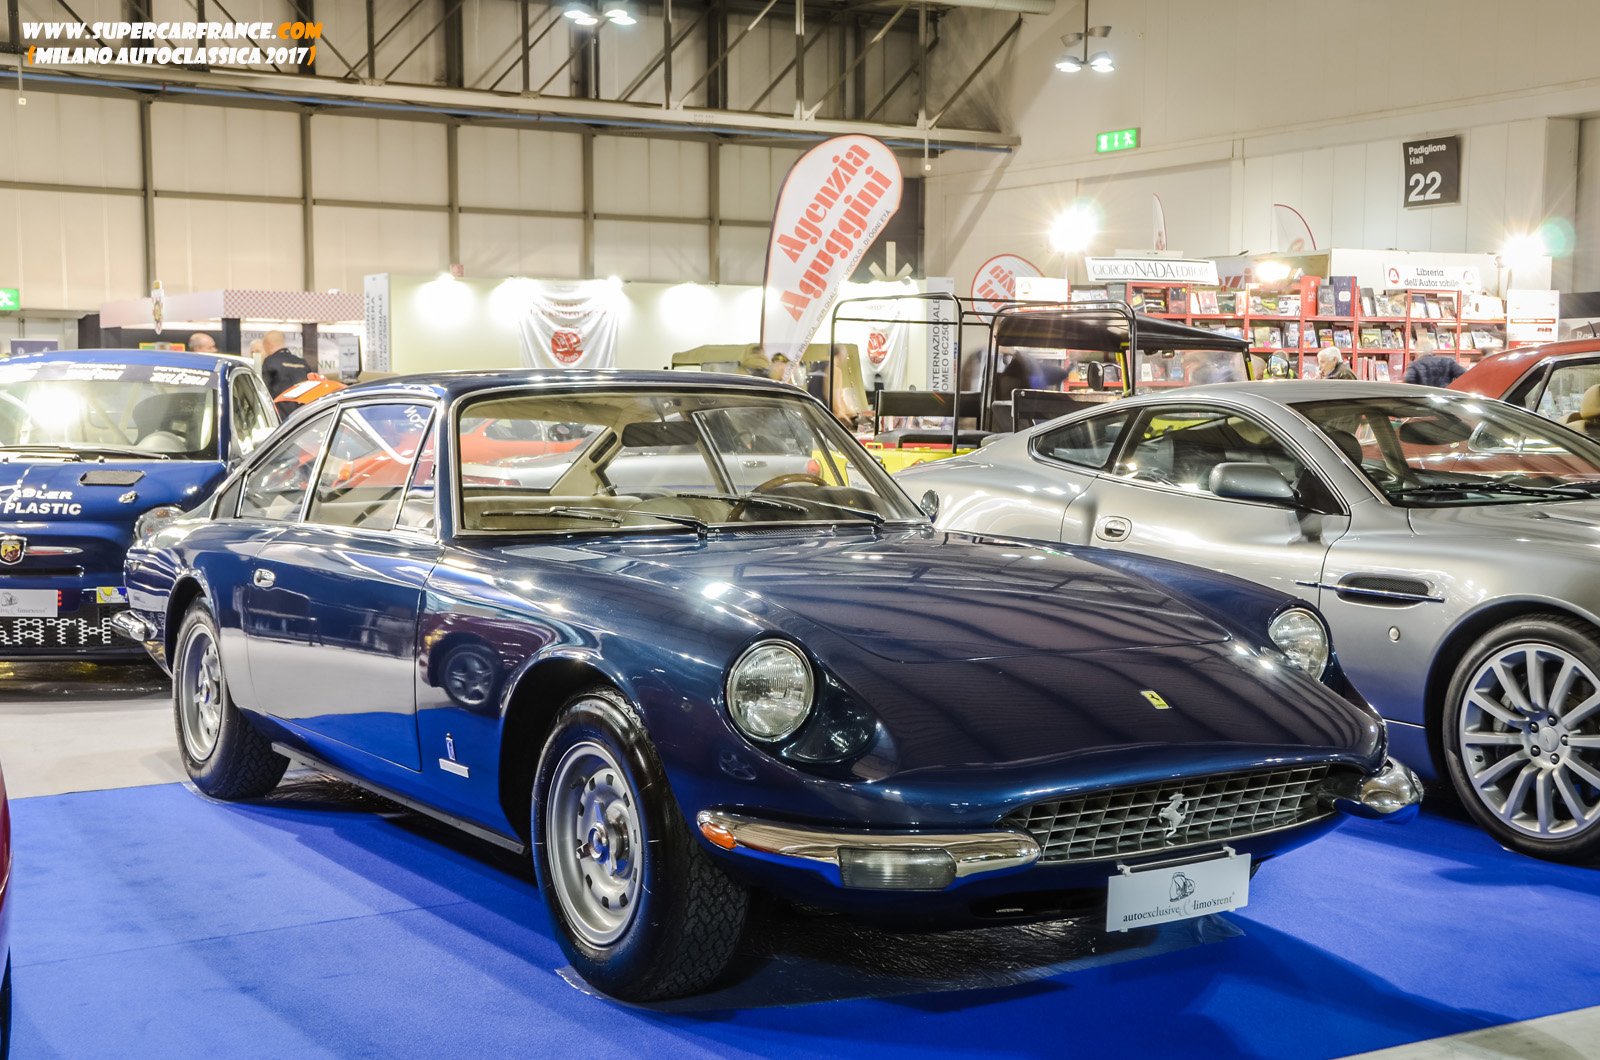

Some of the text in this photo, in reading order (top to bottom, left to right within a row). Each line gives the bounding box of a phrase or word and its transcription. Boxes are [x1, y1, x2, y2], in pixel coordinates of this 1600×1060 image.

[1408, 144, 1447, 155] Padiglione
[1409, 155, 1424, 166] Hall
[1408, 170, 1442, 203] 22
[777, 144, 871, 263] Agenzia
[780, 165, 893, 323] Aguggini
[1092, 263, 1135, 276] GIORGIO
[1135, 261, 1176, 279] NADA
[1416, 268, 1444, 277] Libreria
[3, 502, 82, 516] PLASTIC
[1123, 906, 1180, 922] autoexclusive
